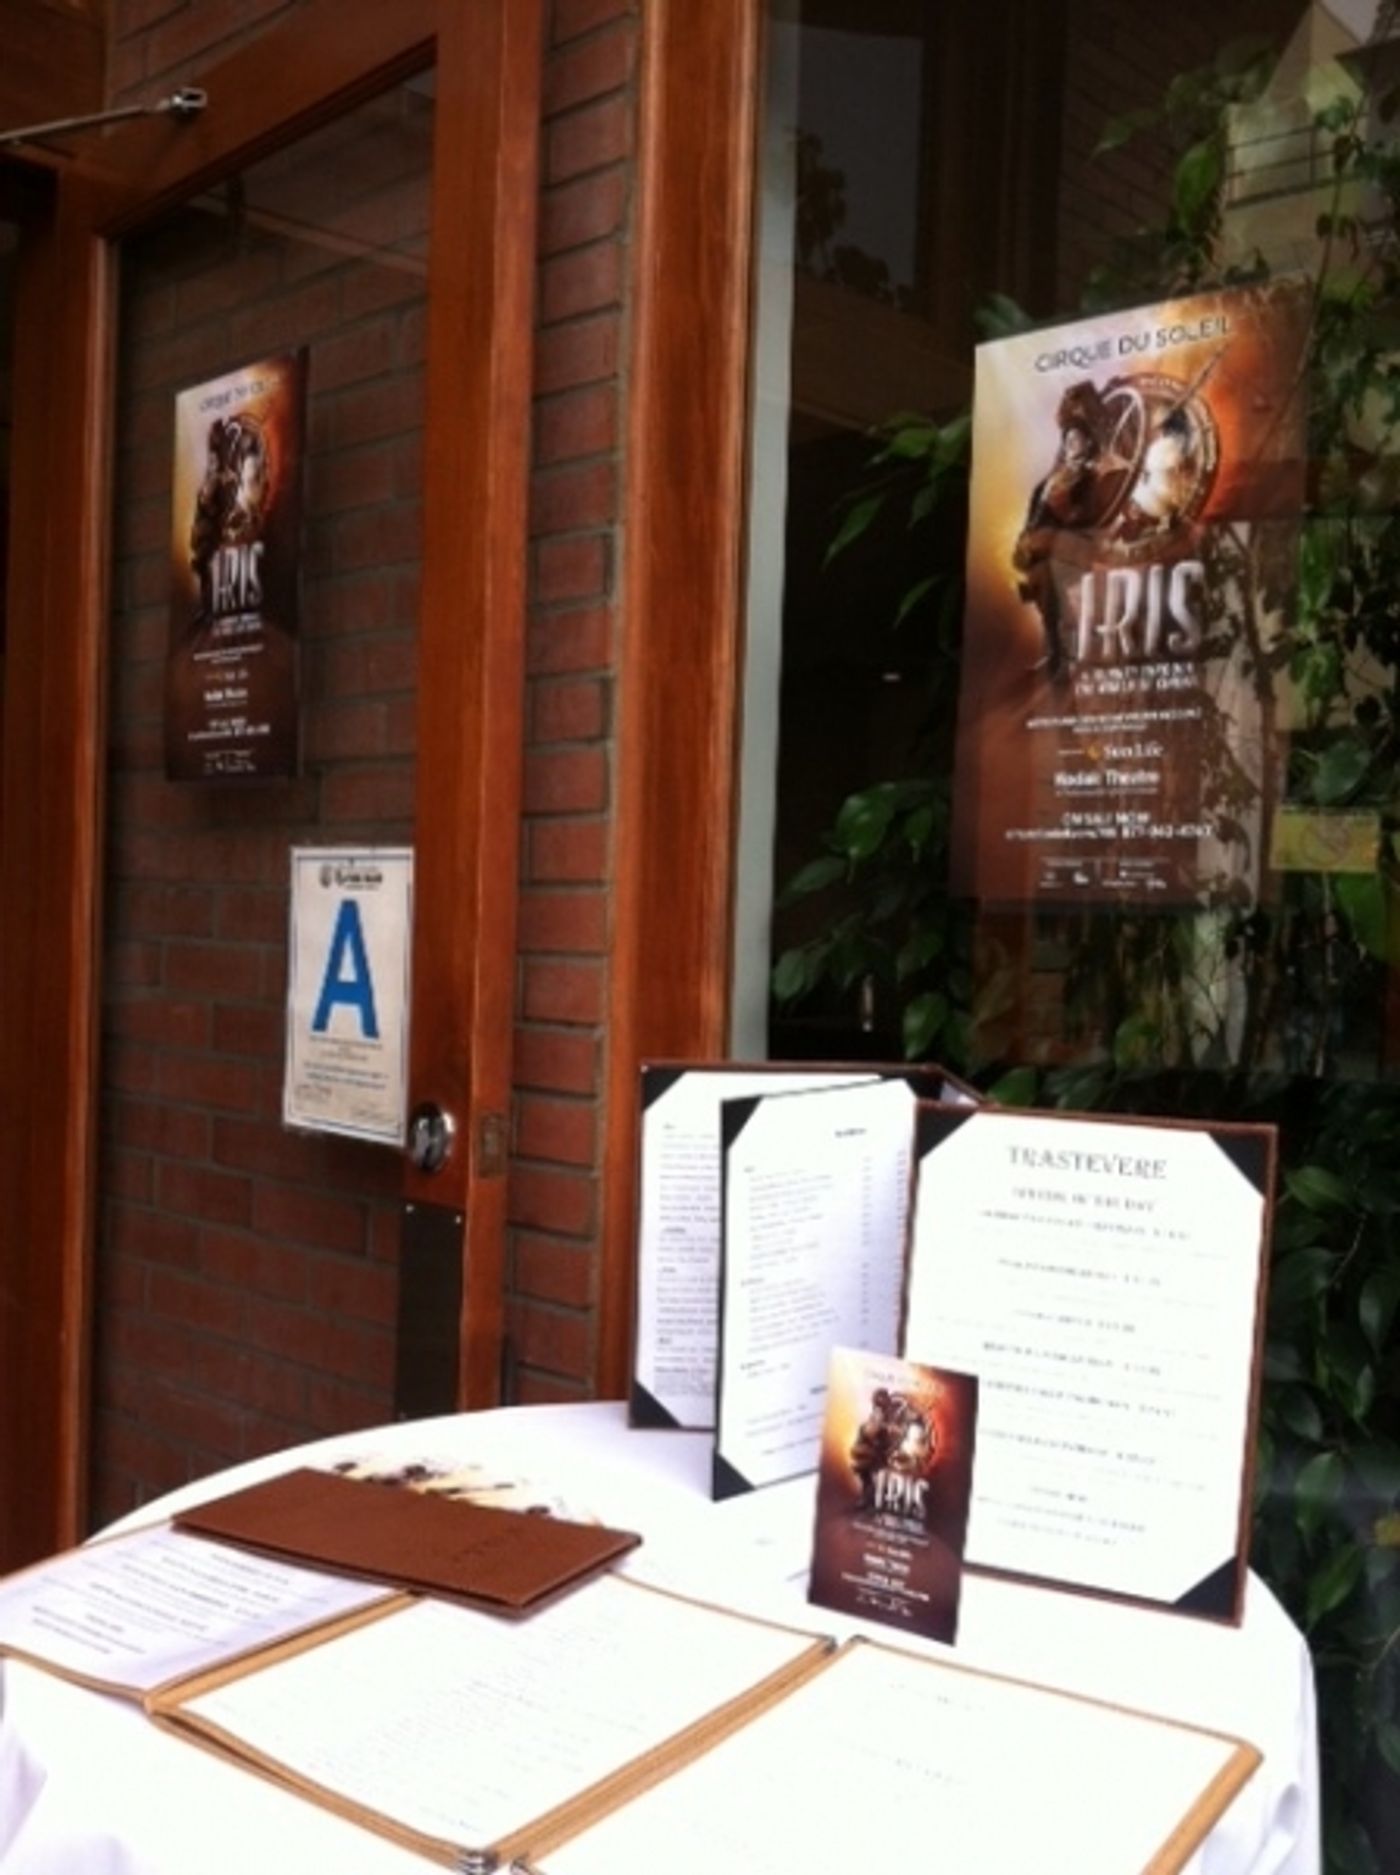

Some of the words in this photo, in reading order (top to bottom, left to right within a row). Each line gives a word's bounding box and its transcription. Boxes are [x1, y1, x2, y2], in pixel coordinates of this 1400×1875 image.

[1035, 340, 1111, 372] CIRQUE
[1118, 332, 1150, 355] DU
[1156, 316, 1228, 349] SOLEIL
[211, 541, 265, 613] IRIS
[1076, 560, 1205, 661] IRIS
[311, 898, 380, 1039] A
[1007, 1145, 1168, 1180] TRASTEVERE
[873, 1468, 930, 1518] IRIS
